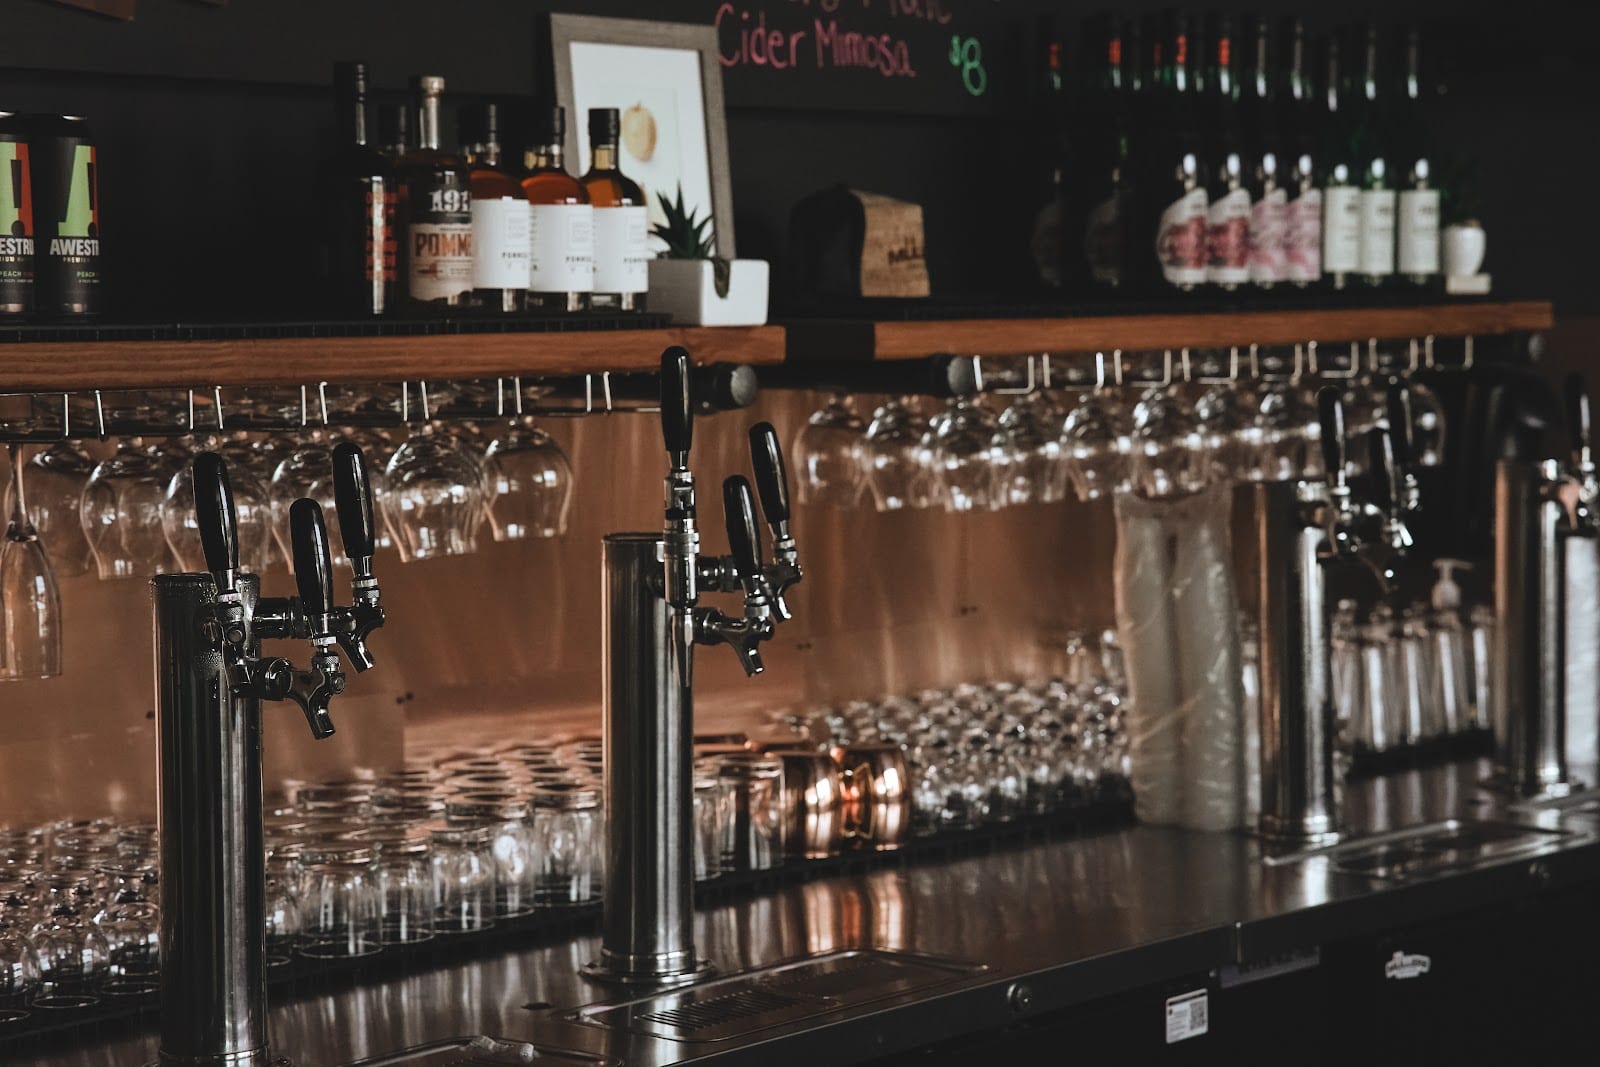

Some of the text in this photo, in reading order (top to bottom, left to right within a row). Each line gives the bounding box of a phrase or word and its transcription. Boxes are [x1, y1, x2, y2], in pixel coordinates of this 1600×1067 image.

[714, 2, 807, 69] Cider
[814, 18, 917, 77] Mimosa
[428, 189, 472, 213] 191
